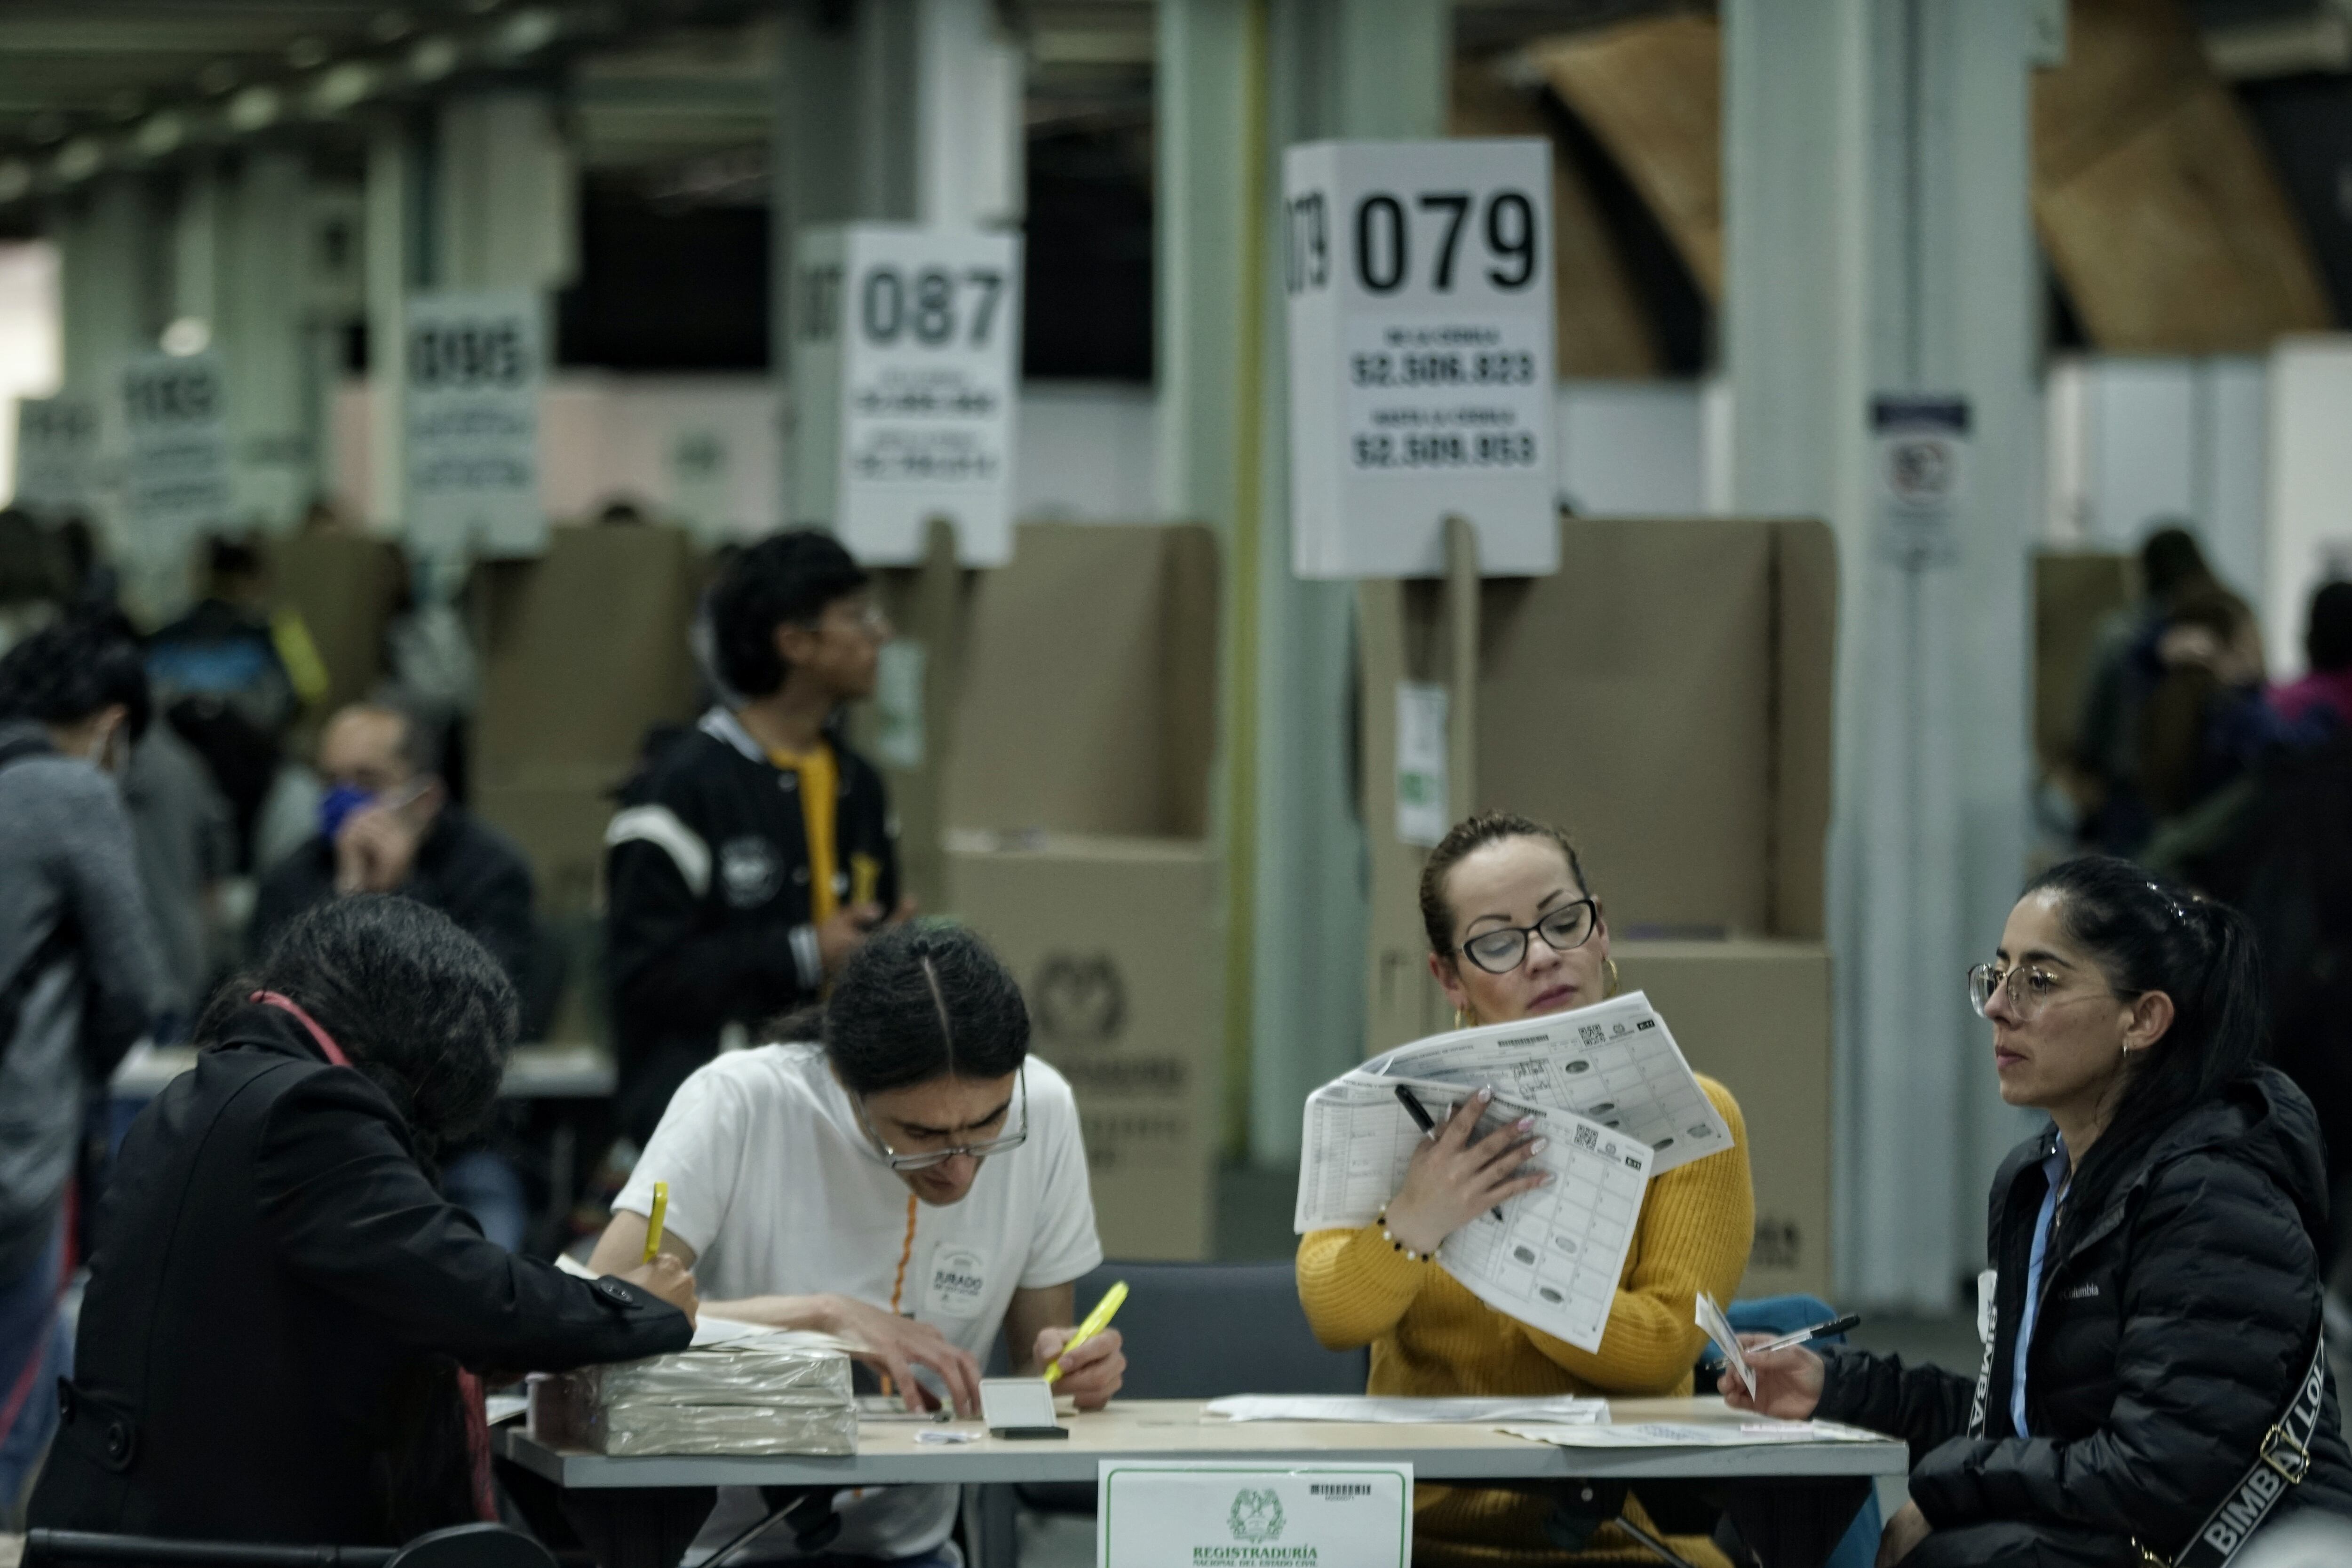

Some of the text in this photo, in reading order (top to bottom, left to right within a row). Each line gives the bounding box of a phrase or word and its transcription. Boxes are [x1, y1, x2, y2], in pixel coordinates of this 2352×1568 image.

[1356, 193, 1536, 293] 079
[863, 263, 1002, 349] 087
[2063, 1282, 2099, 1299] Columbia
[2203, 1450, 2302, 1555] BIMBA
[2295, 1340, 2323, 1428] LOL
[1193, 1544, 1317, 1559] REGISTRADURÍA
